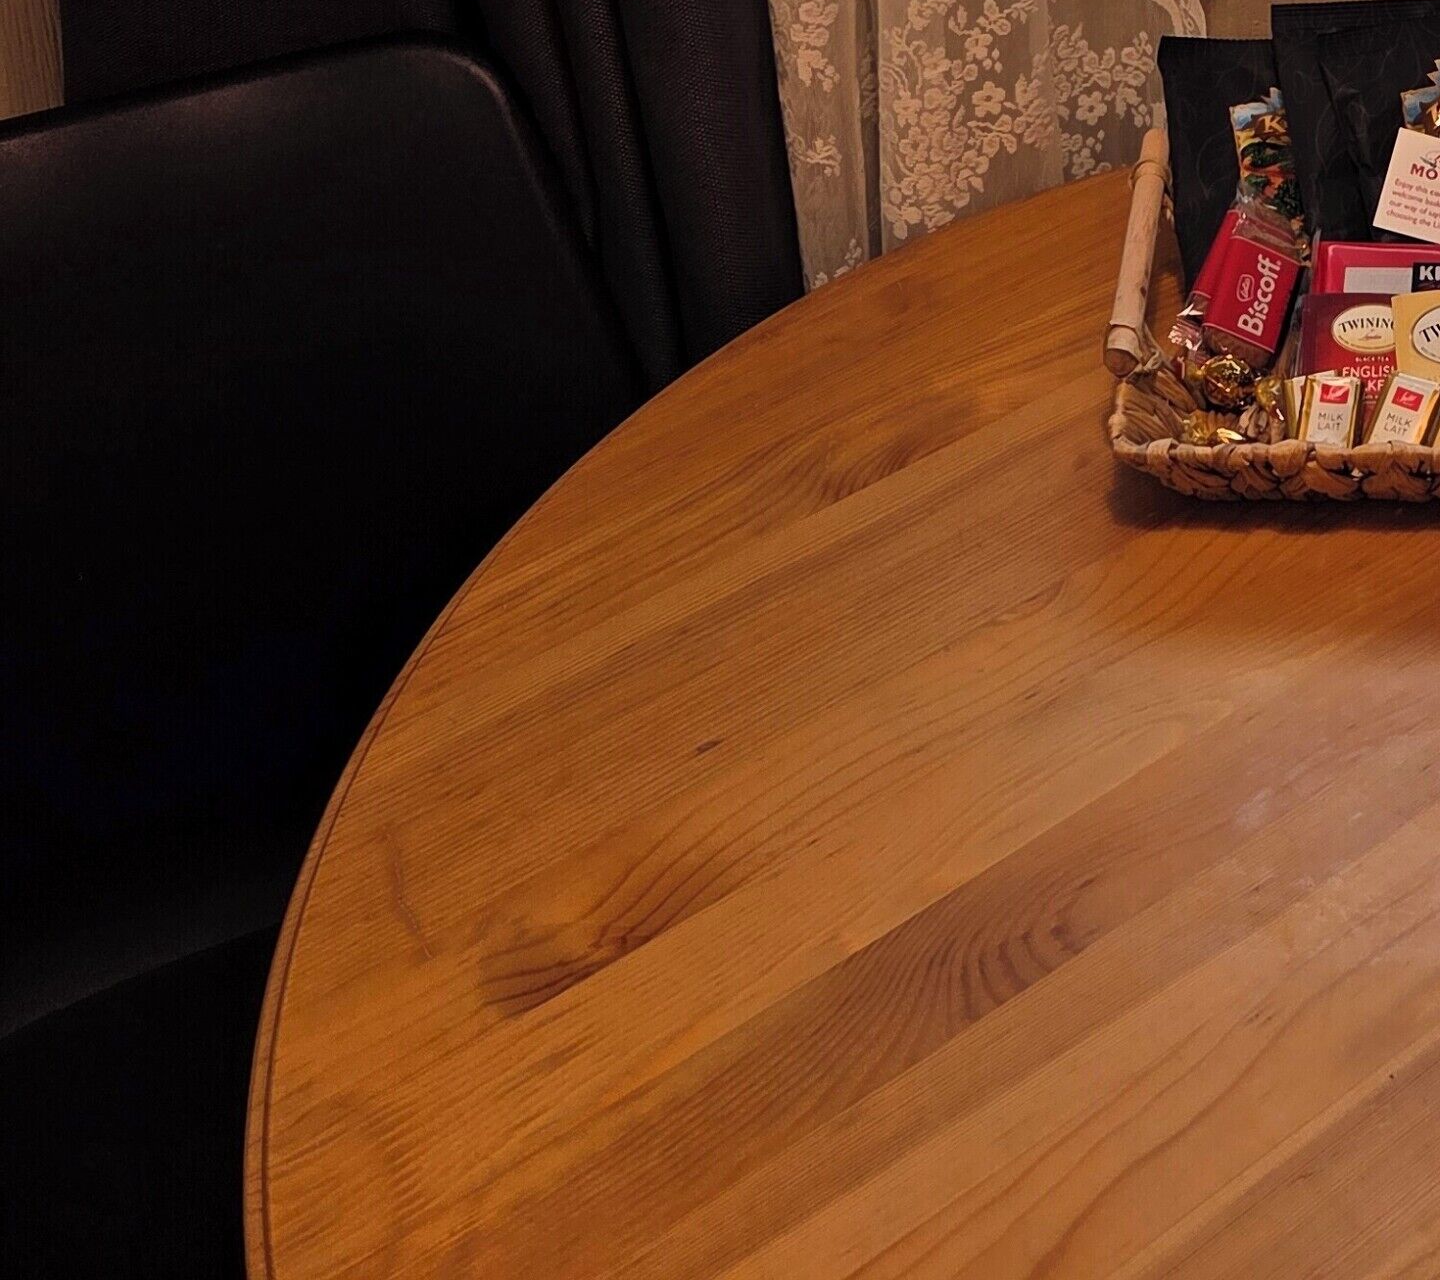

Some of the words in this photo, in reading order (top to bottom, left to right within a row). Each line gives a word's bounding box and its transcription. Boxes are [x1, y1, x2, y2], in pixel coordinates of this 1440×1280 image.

[1318, 412, 1344, 422] MILK
[1387, 412, 1412, 427] MILK
[1317, 422, 1341, 432] LAIT
[1384, 425, 1408, 436] LAIT
